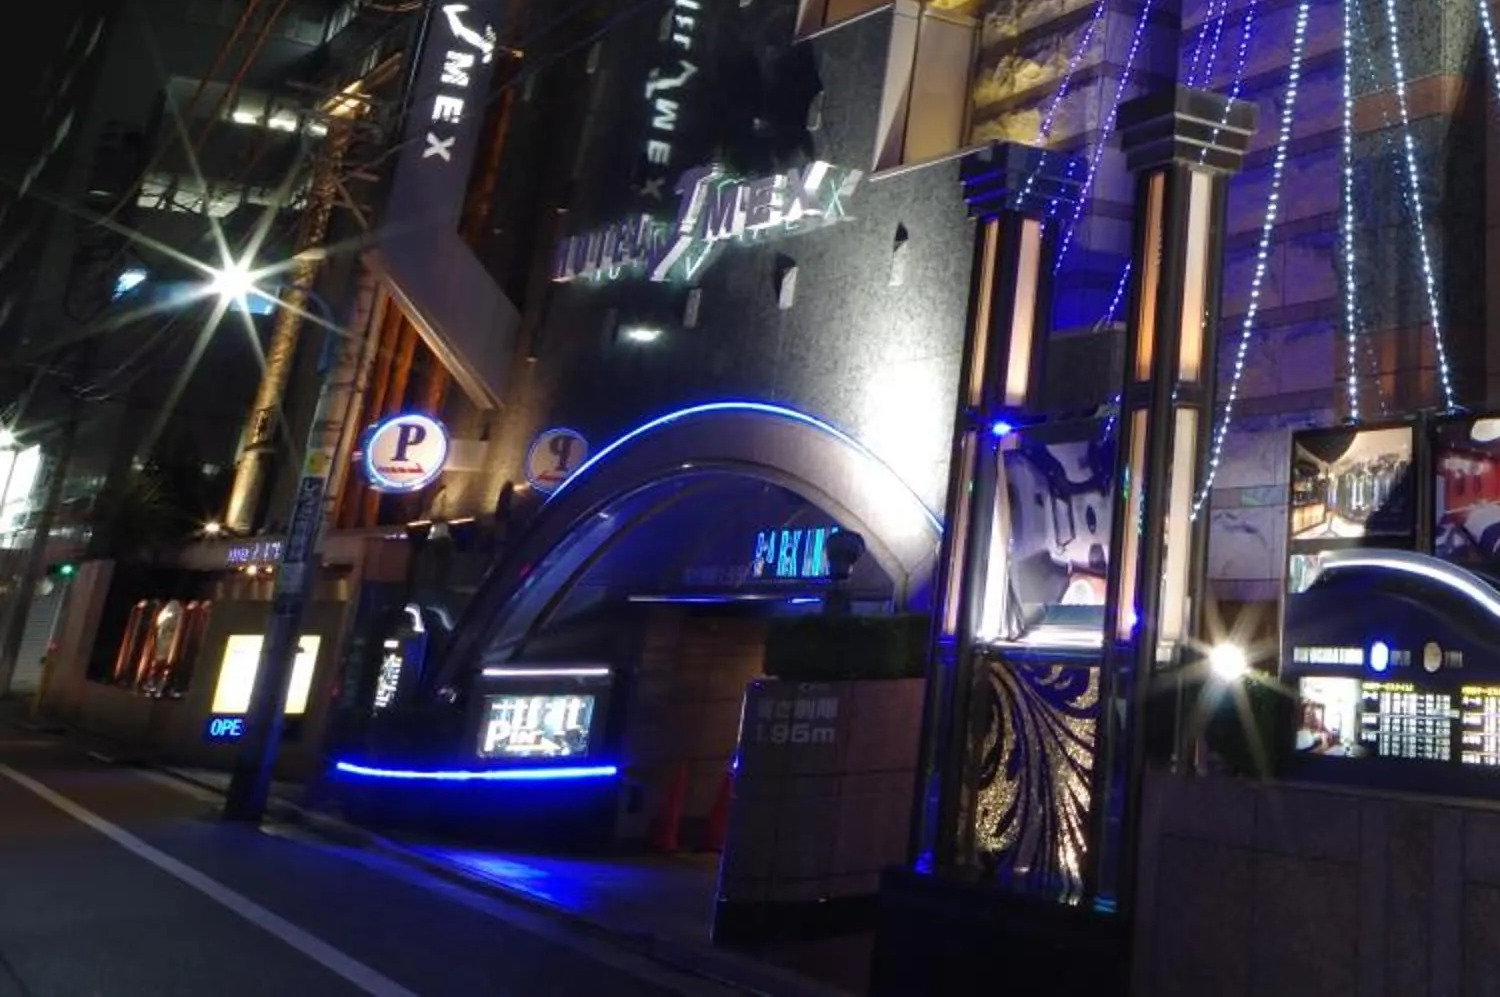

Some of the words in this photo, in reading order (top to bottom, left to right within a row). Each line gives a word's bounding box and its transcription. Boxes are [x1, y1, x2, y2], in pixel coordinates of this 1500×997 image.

[422, 50, 475, 163] MEX
[391, 423, 427, 462] P
[752, 526, 839, 578] PARKIN
[210, 718, 243, 736] OPE
